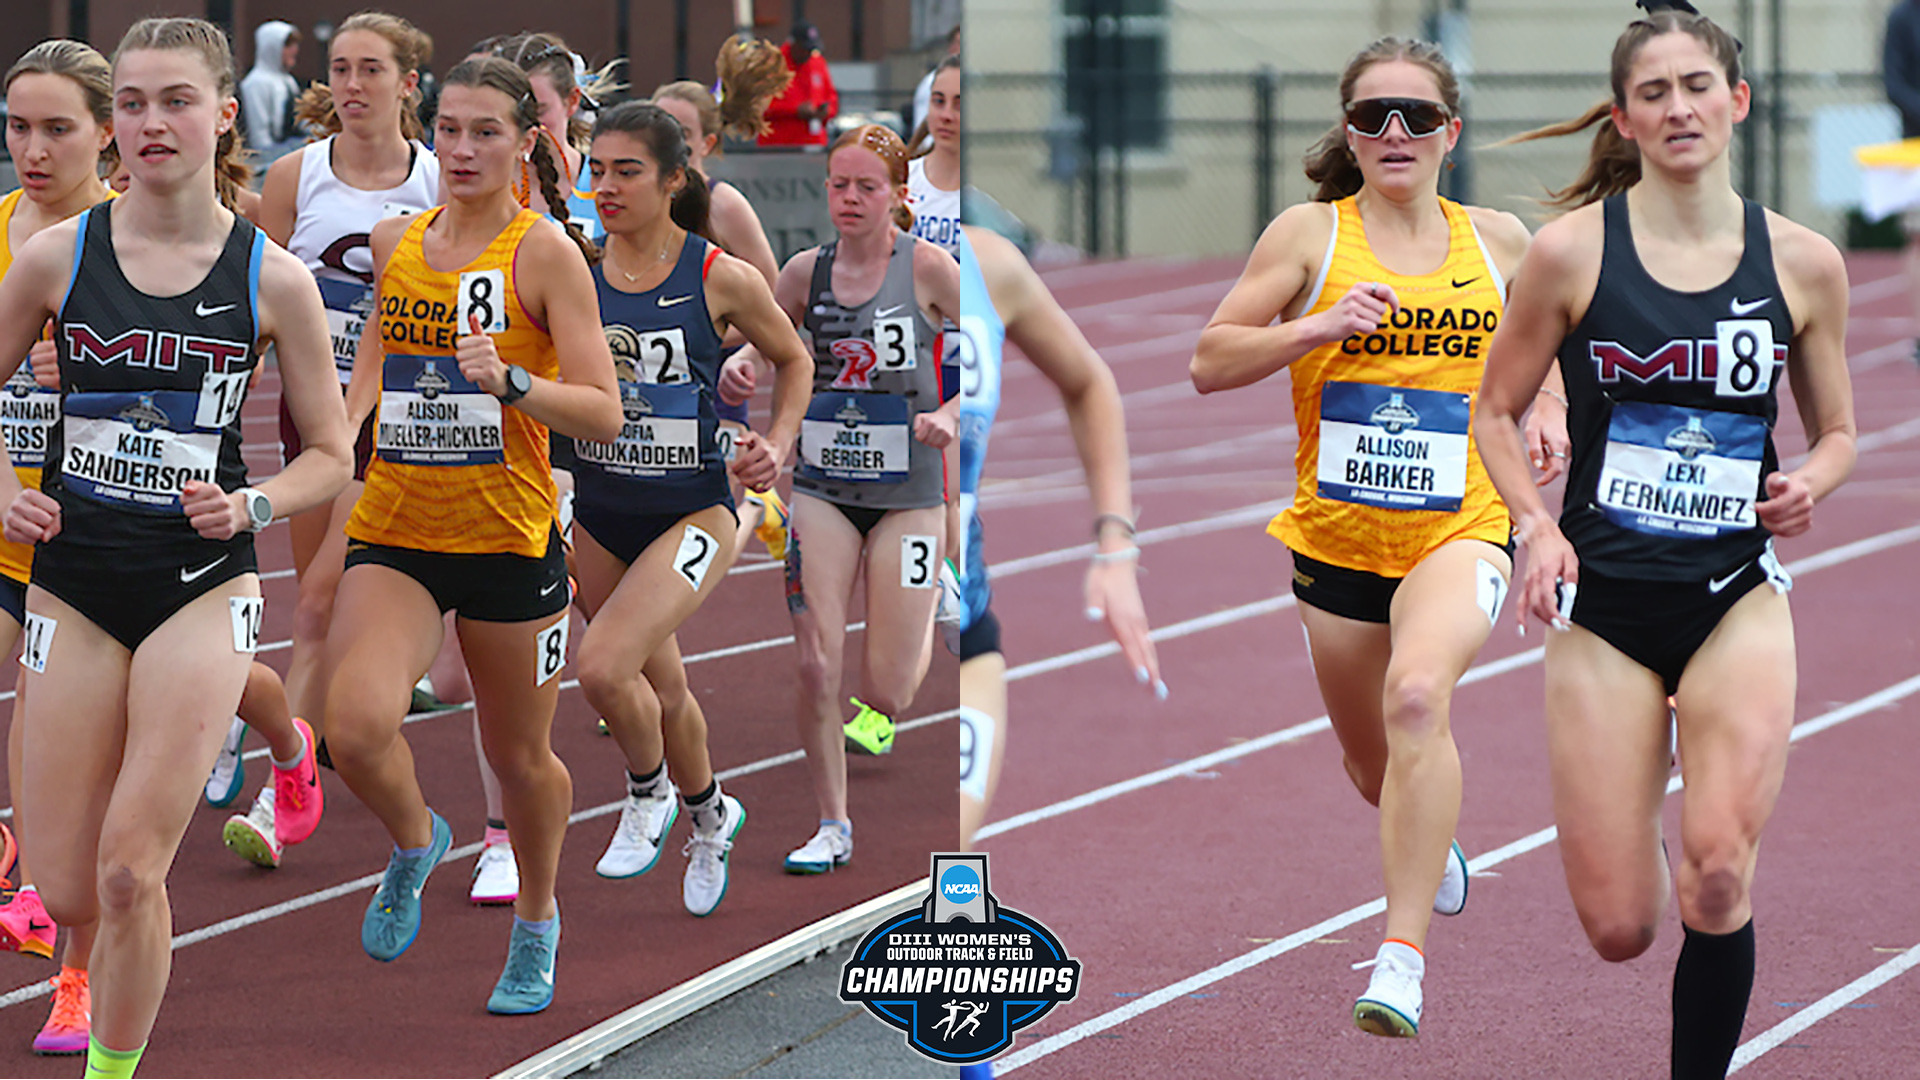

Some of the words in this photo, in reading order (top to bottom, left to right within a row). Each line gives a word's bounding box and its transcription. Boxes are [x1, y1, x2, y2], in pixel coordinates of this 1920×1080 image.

[468, 276, 493, 331] 8
[64, 323, 249, 374] MIT
[650, 337, 680, 383] 2
[884, 324, 906, 367] 3
[1341, 334, 1482, 359] COLLEGE
[1730, 329, 1761, 392] 8
[213, 376, 241, 424] 14
[408, 401, 459, 420] ALISON
[117, 432, 165, 459] KATE
[576, 439, 696, 465] MOUKADDEM
[821, 448, 884, 468] BERGER
[833, 430, 870, 446] JOLEY
[1356, 434, 1429, 460] ALLISON
[68, 447, 210, 491] SANDERSON
[1345, 458, 1435, 492] BARKER
[1665, 462, 1706, 485] LEXI
[1607, 477, 1749, 523] FERNANDEZ
[681, 533, 708, 582] 2
[909, 541, 929, 585] 3
[545, 629, 561, 675] 8
